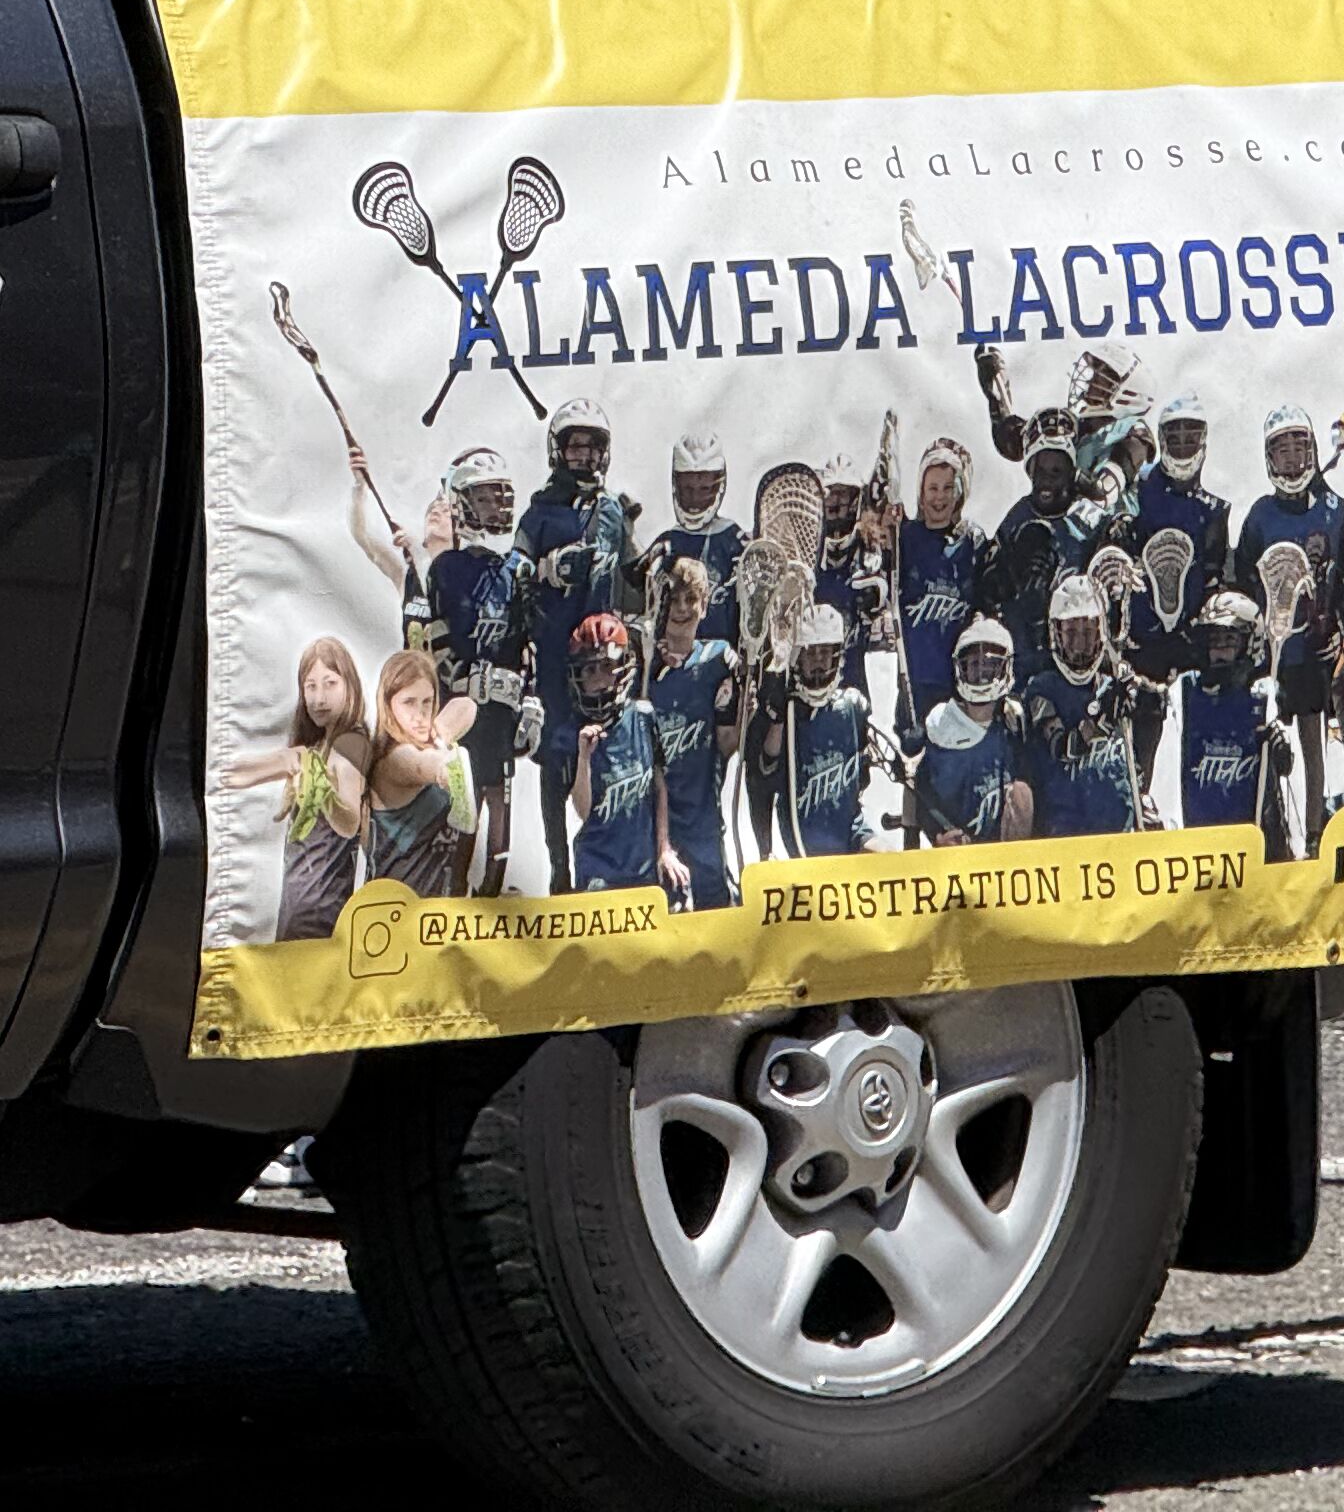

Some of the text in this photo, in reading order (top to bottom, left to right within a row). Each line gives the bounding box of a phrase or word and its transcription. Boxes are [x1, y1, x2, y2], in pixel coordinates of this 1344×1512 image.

[450, 252, 918, 372] ALAMEDA
[418, 852, 1249, 947] @ALAMEDALAX REGISTRATION IS OPEN
